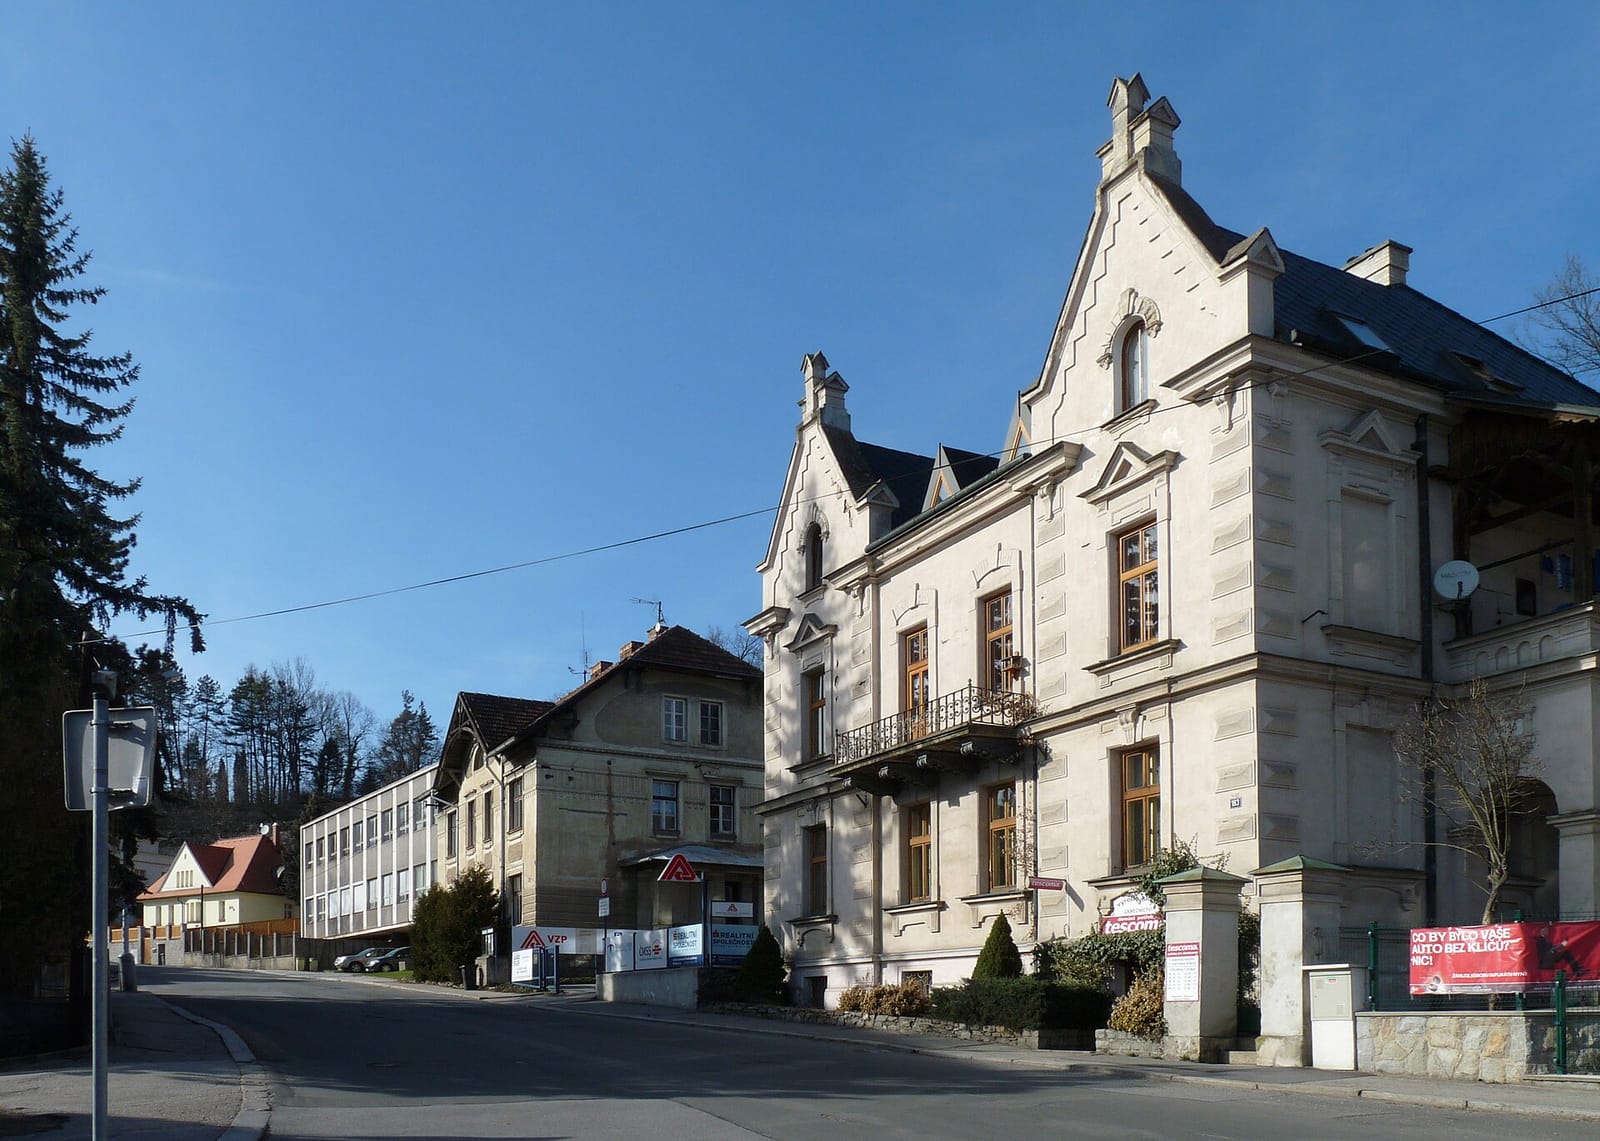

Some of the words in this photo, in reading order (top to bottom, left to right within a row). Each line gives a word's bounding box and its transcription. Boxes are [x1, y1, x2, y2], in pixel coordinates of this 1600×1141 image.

[547, 935, 568, 944] VZP
[1412, 932, 1426, 943] CO
[1428, 931, 1447, 942] BY
[1449, 930, 1478, 941] BYLO
[1480, 926, 1511, 940] VAŠE
[1412, 943, 1443, 954] AUTO
[1444, 943, 1466, 953] BEZ
[1467, 938, 1510, 952] KLÍČŮ?
[1412, 955, 1433, 966] NIC!
